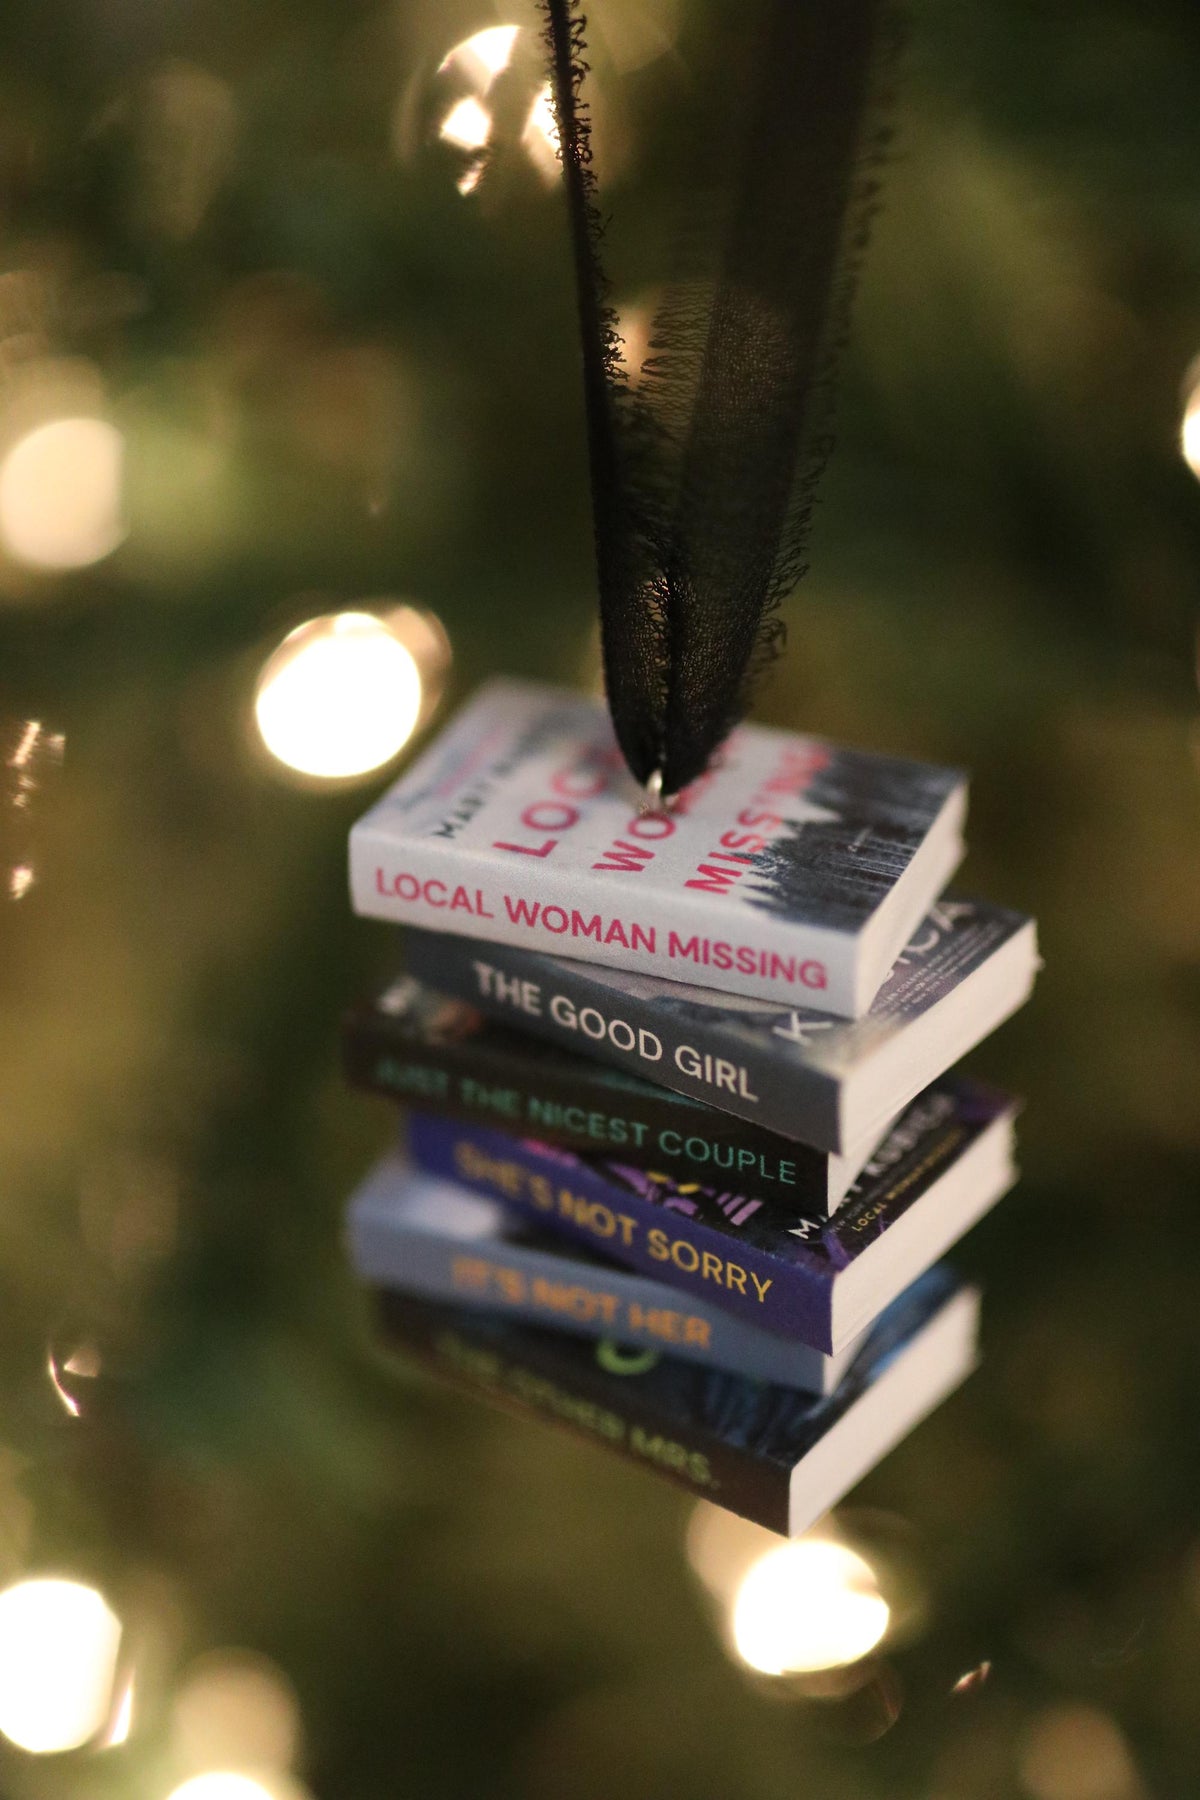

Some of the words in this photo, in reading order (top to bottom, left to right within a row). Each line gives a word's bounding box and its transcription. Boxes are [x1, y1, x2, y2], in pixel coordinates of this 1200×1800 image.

[376, 868, 493, 919] LOCAL
[504, 895, 656, 954] WOMAN
[667, 930, 828, 990] MISSING
[472, 960, 542, 1017] THE
[550, 996, 663, 1062] GOOD
[674, 1044, 759, 1102] GIRL
[461, 1077, 520, 1116] THE
[528, 1096, 650, 1149] NICEST
[659, 1130, 797, 1186] COUPLE
[559, 1188, 639, 1247] NOT
[648, 1228, 774, 1304] SORRY
[851, 1202, 888, 1232] LOCAL
[532, 1278, 619, 1323] NOT
[629, 1304, 712, 1349] HER
